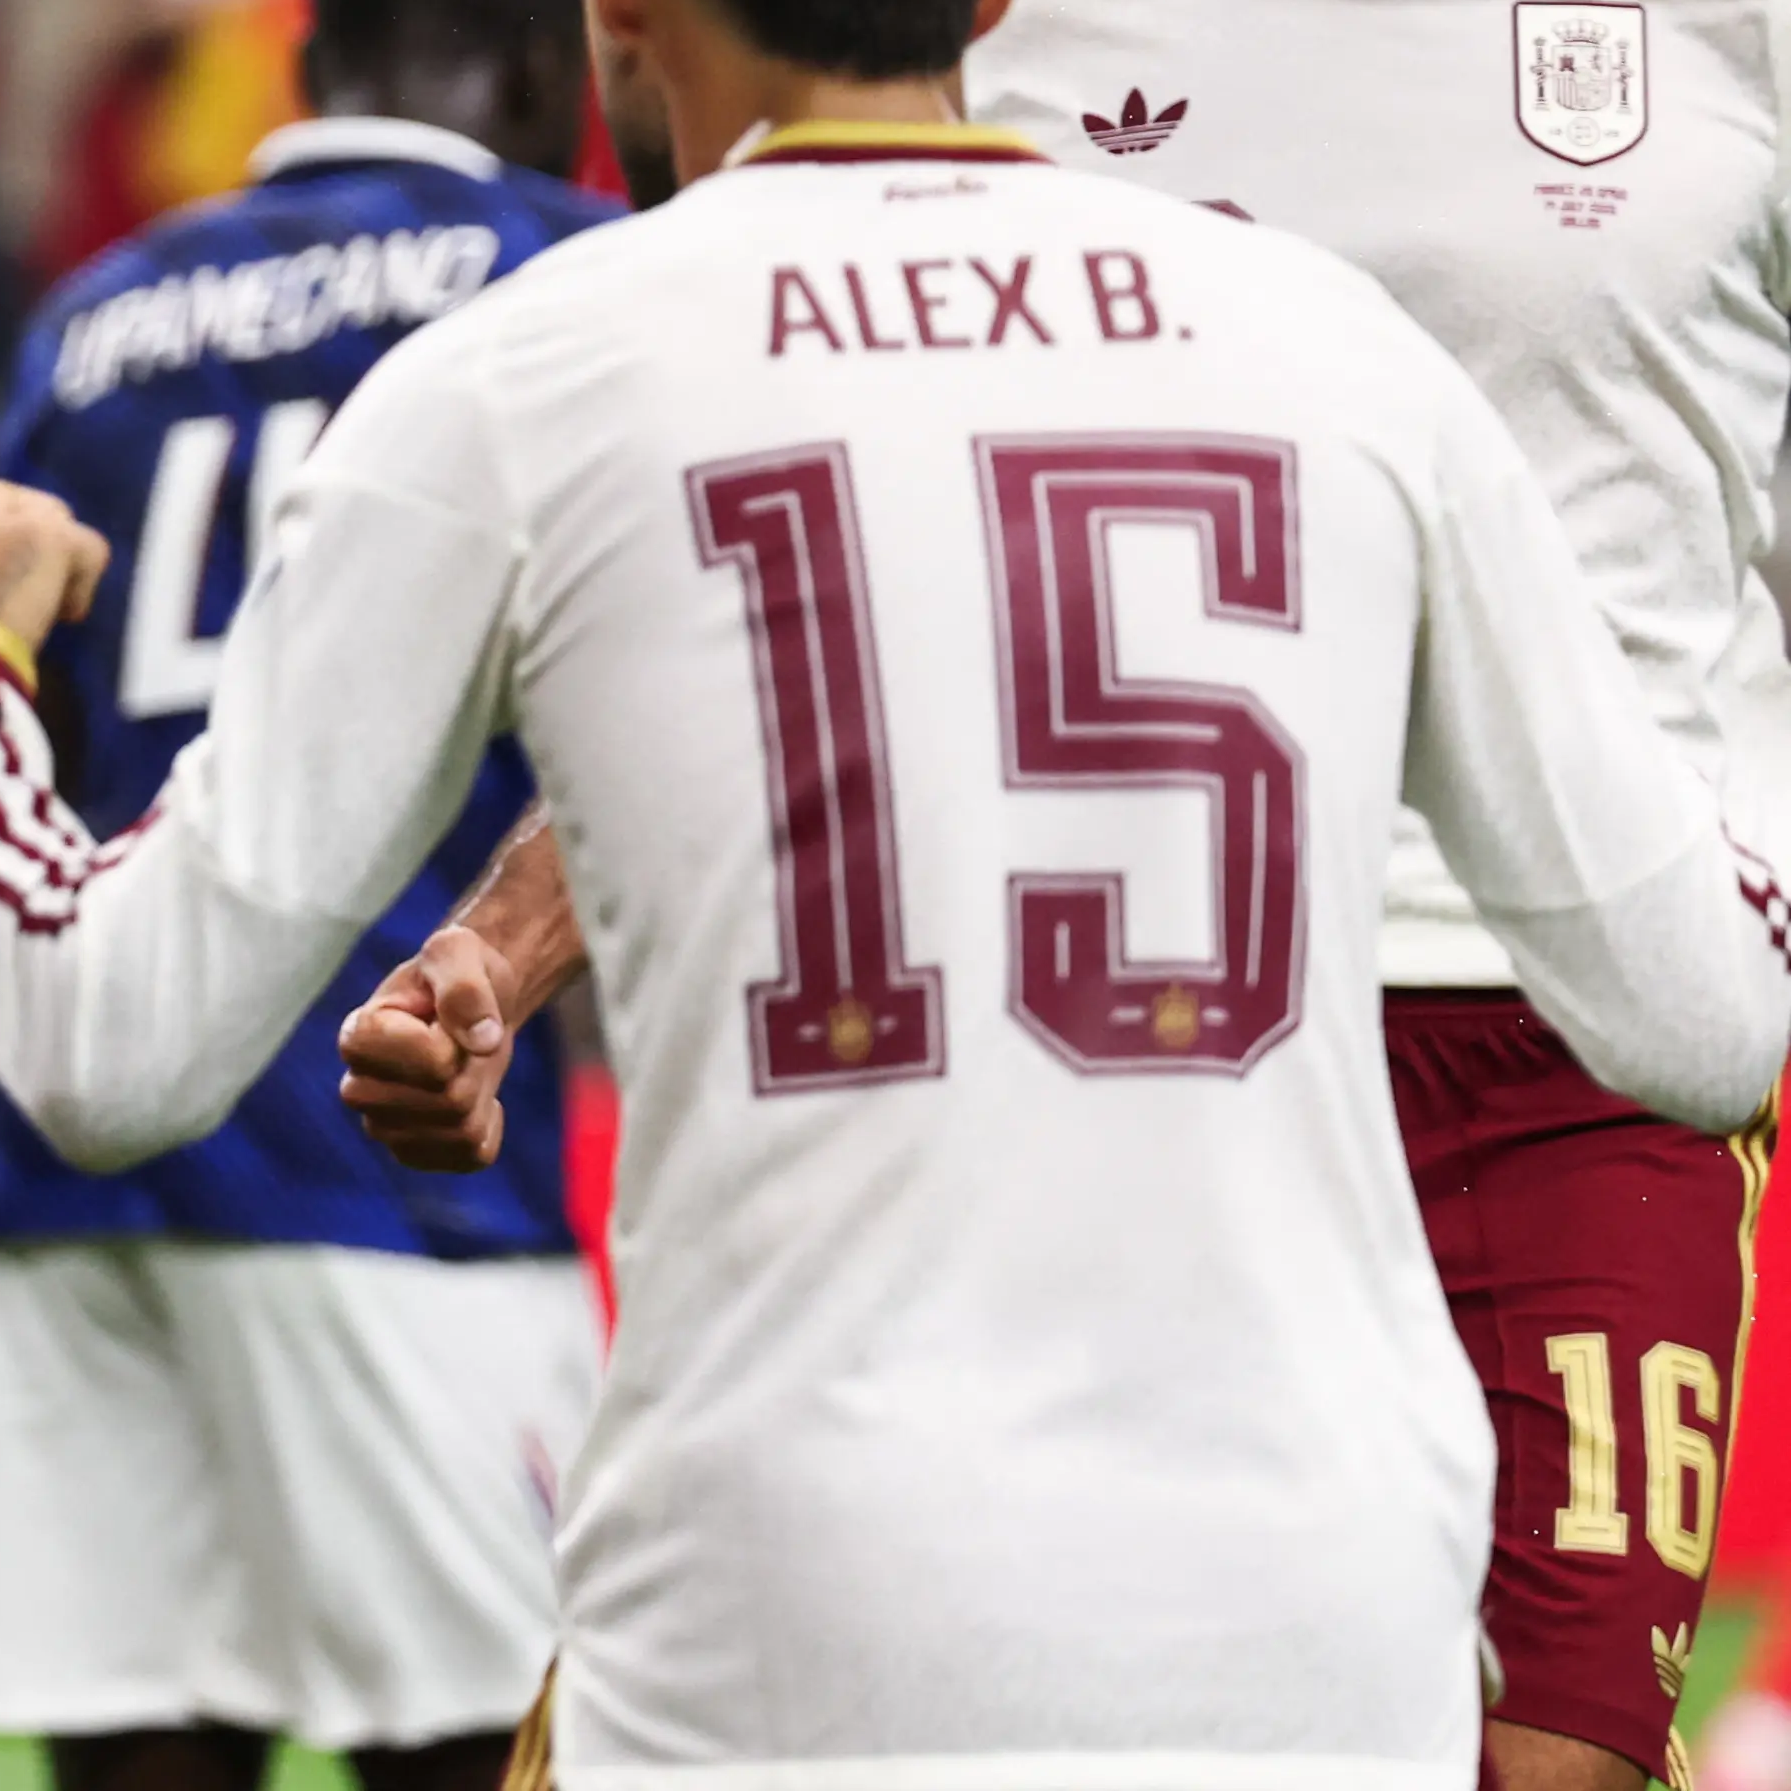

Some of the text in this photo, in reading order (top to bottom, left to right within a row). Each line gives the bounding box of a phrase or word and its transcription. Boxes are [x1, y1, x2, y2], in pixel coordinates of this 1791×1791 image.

[766, 249, 1194, 357] ALEX B.
[683, 430, 1308, 1096] 15
[1545, 1332, 1720, 1581] 16
